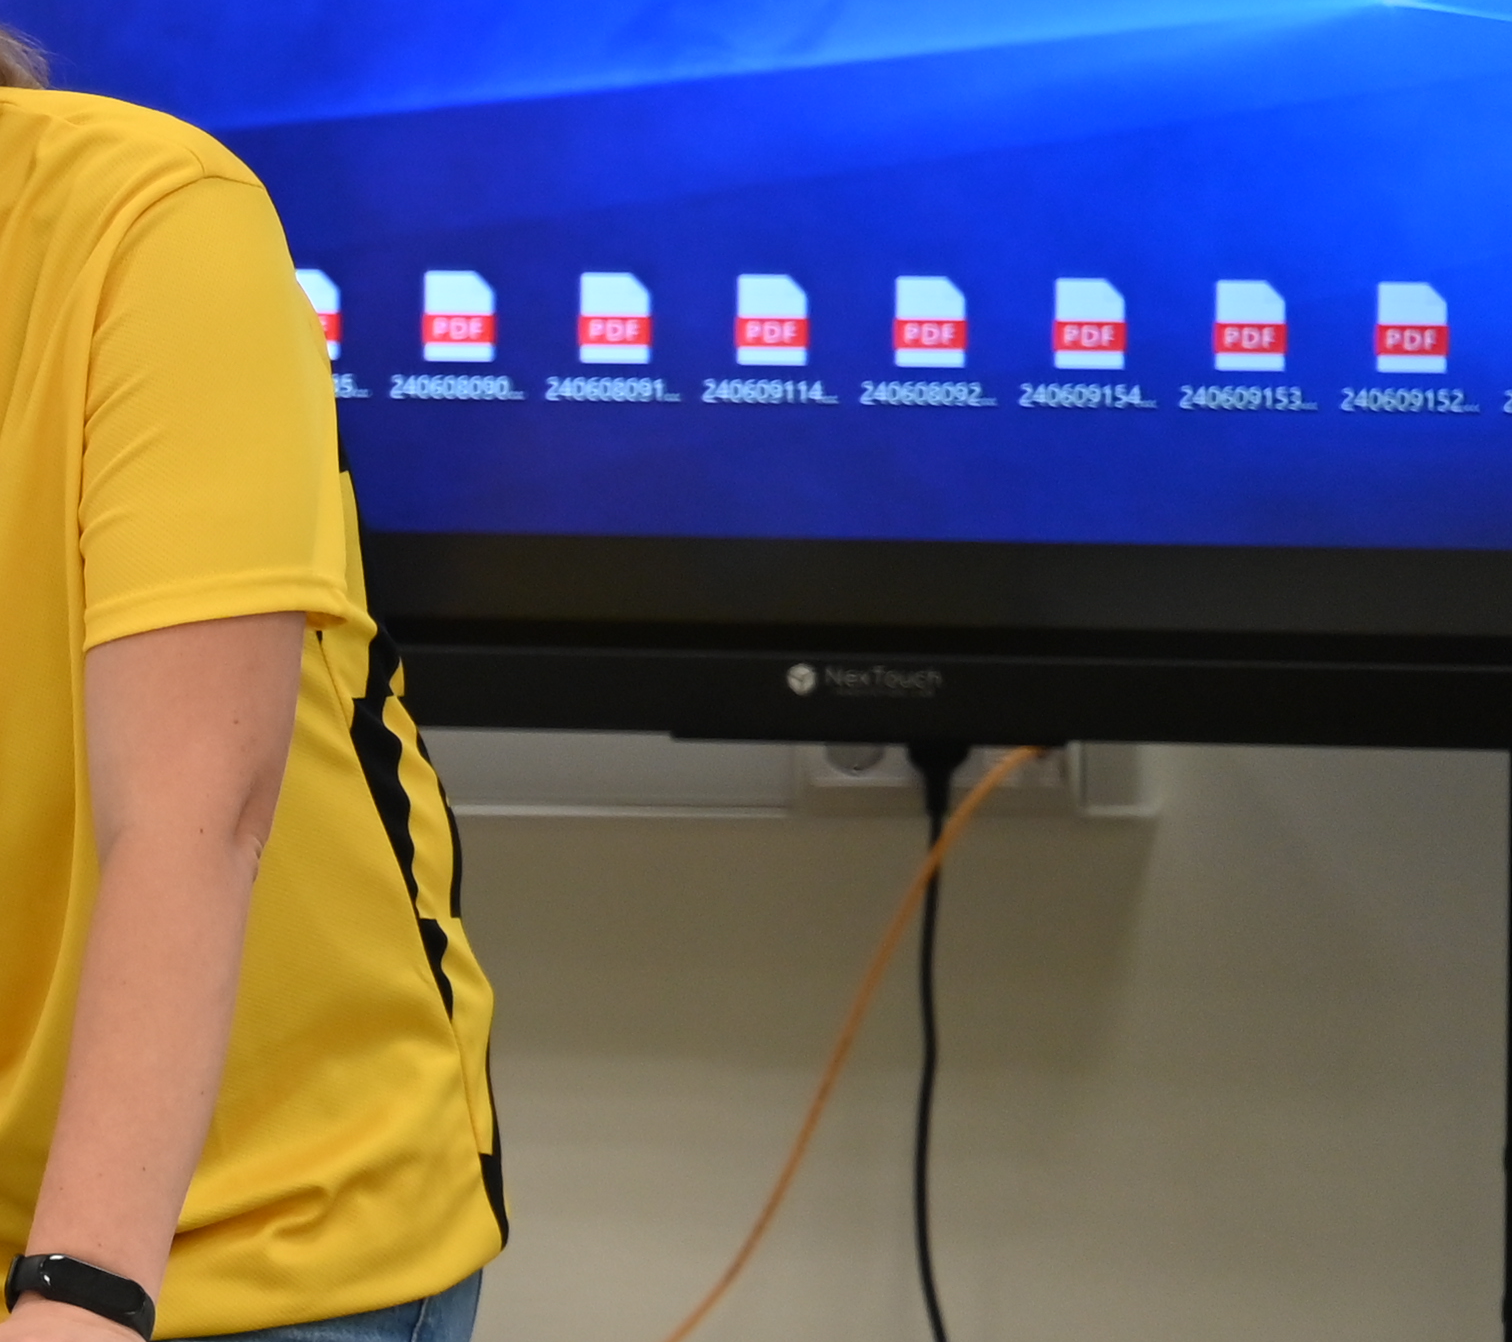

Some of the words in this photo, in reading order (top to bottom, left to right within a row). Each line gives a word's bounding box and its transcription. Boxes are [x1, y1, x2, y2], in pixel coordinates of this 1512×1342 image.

[431, 316, 483, 341] PDF
[587, 318, 639, 343] PDF
[743, 320, 797, 344] PDF
[901, 322, 955, 346] PDF
[1060, 324, 1114, 348] PDF
[1221, 326, 1275, 350] PDF
[1383, 328, 1435, 352] PDF
